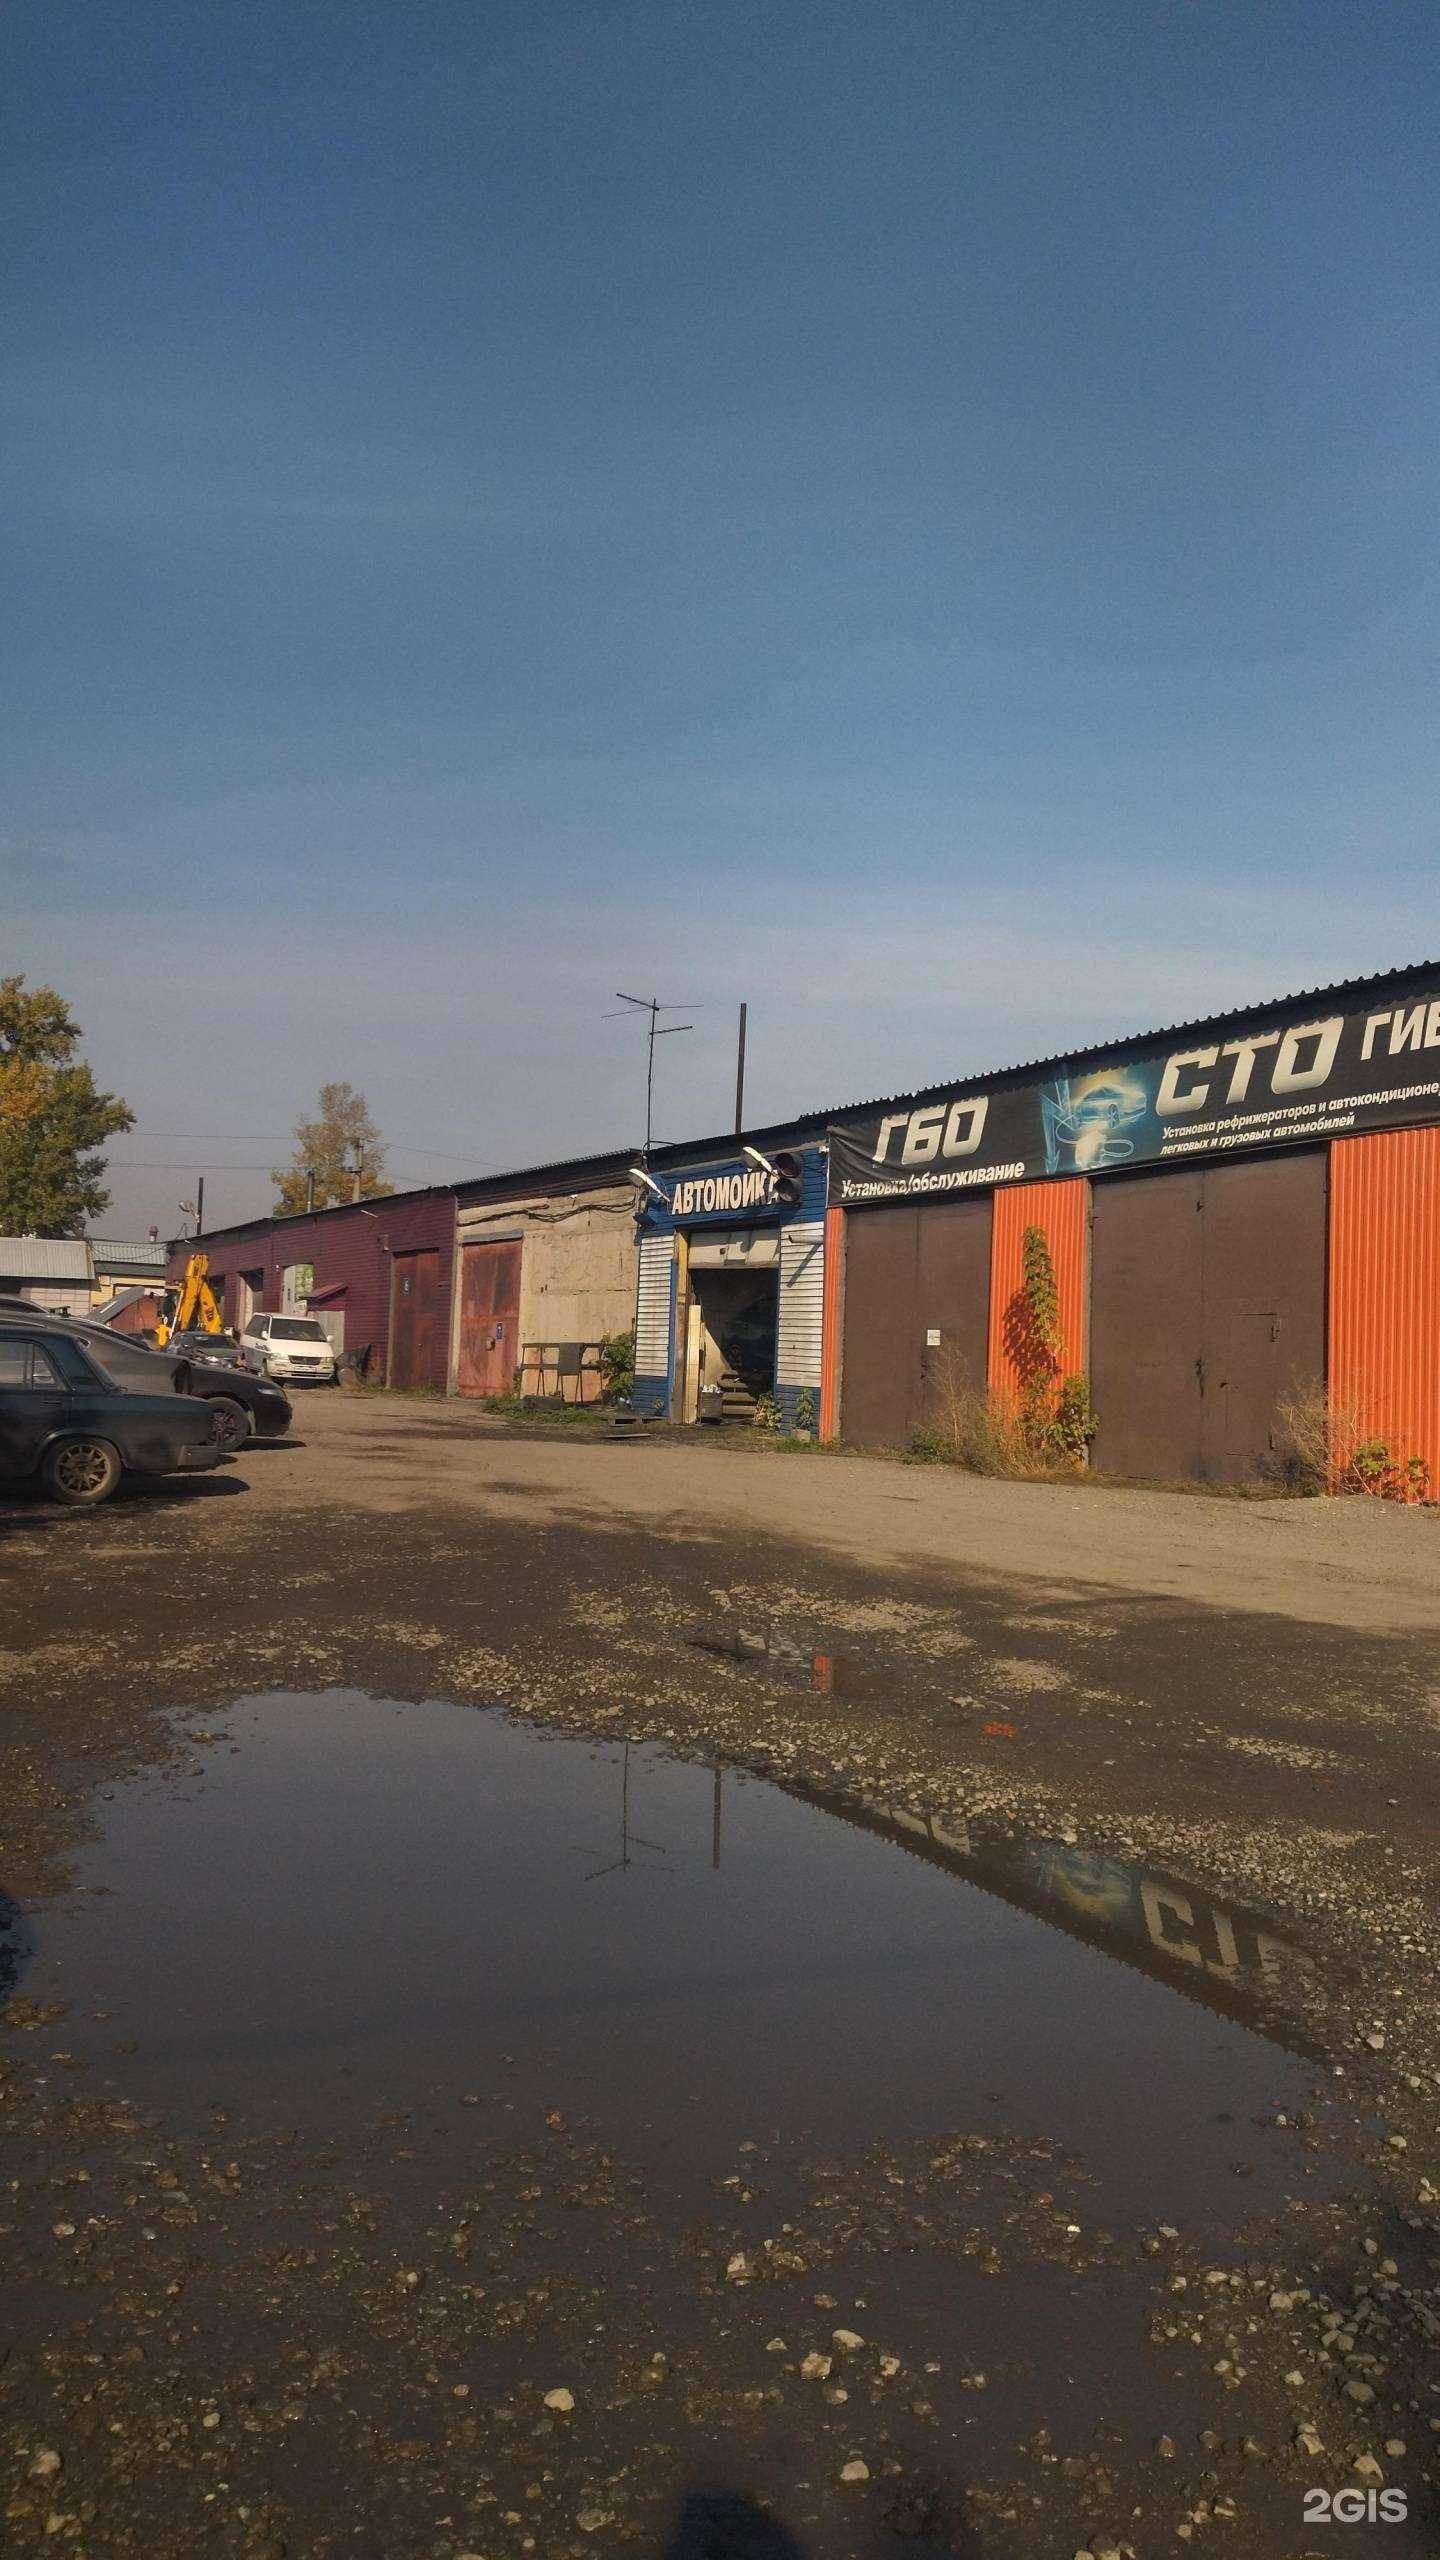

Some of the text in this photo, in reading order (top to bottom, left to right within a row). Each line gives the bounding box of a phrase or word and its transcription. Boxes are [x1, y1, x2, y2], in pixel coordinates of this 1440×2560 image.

[1155, 1016, 1345, 1116] СТО
[872, 1096, 989, 1165] ГБО
[1160, 1111, 1355, 1155] легковых и грузовых автомобилей
[1162, 1082, 1440, 1139] Установка рефрижераторов и автокондиционе
[841, 1161, 1025, 1198] Установка/обслуживание
